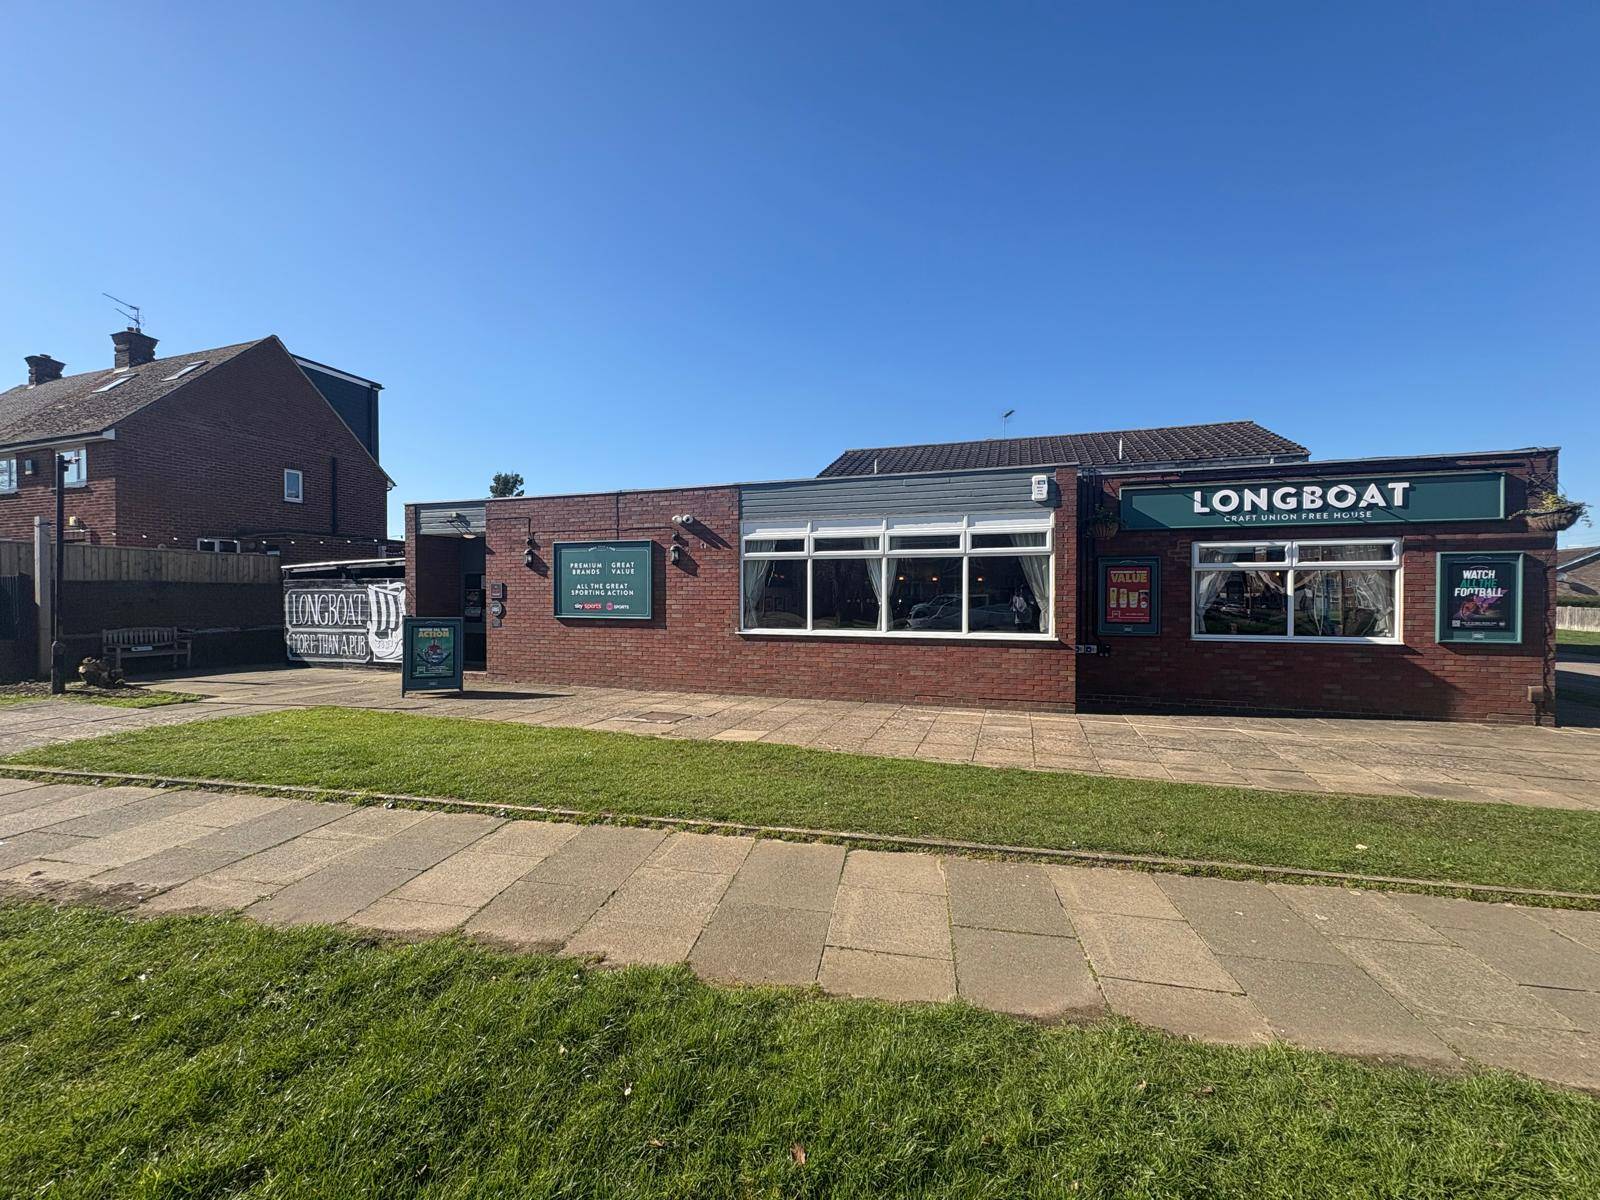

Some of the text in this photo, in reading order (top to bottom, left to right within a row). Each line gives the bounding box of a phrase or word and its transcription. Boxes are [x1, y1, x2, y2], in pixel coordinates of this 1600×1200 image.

[1194, 482, 1410, 513] LONGBOAT
[1224, 511, 1373, 523] CRAFT UNION FREE HOUSE
[1111, 573, 1148, 583] VALUE
[1462, 569, 1496, 579] WATCH
[1460, 579, 1498, 587] ALL THE
[1454, 587, 1504, 597] FOOTBALL
[291, 593, 366, 626] LONGBOAT
[292, 634, 366, 656] MORE THAN A PUB
